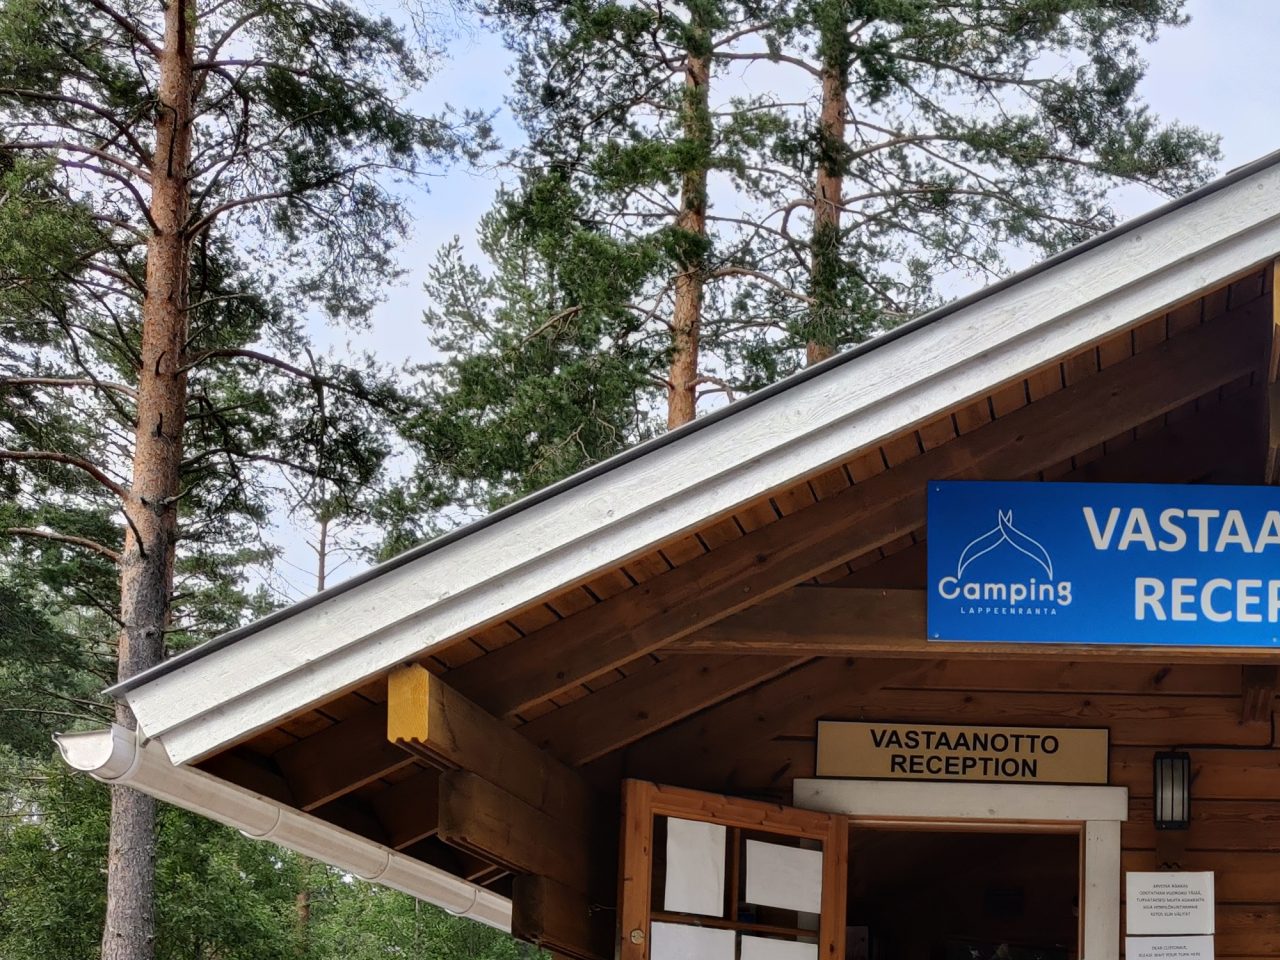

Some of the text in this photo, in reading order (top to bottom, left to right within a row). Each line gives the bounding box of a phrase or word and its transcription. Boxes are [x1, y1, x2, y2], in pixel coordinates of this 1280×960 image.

[938, 576, 1072, 606] Camping
[960, 607, 1057, 615] LAPPEENRANTA
[870, 729, 1060, 755] VASTAANOTTO
[890, 754, 1038, 778] RECEPTION
